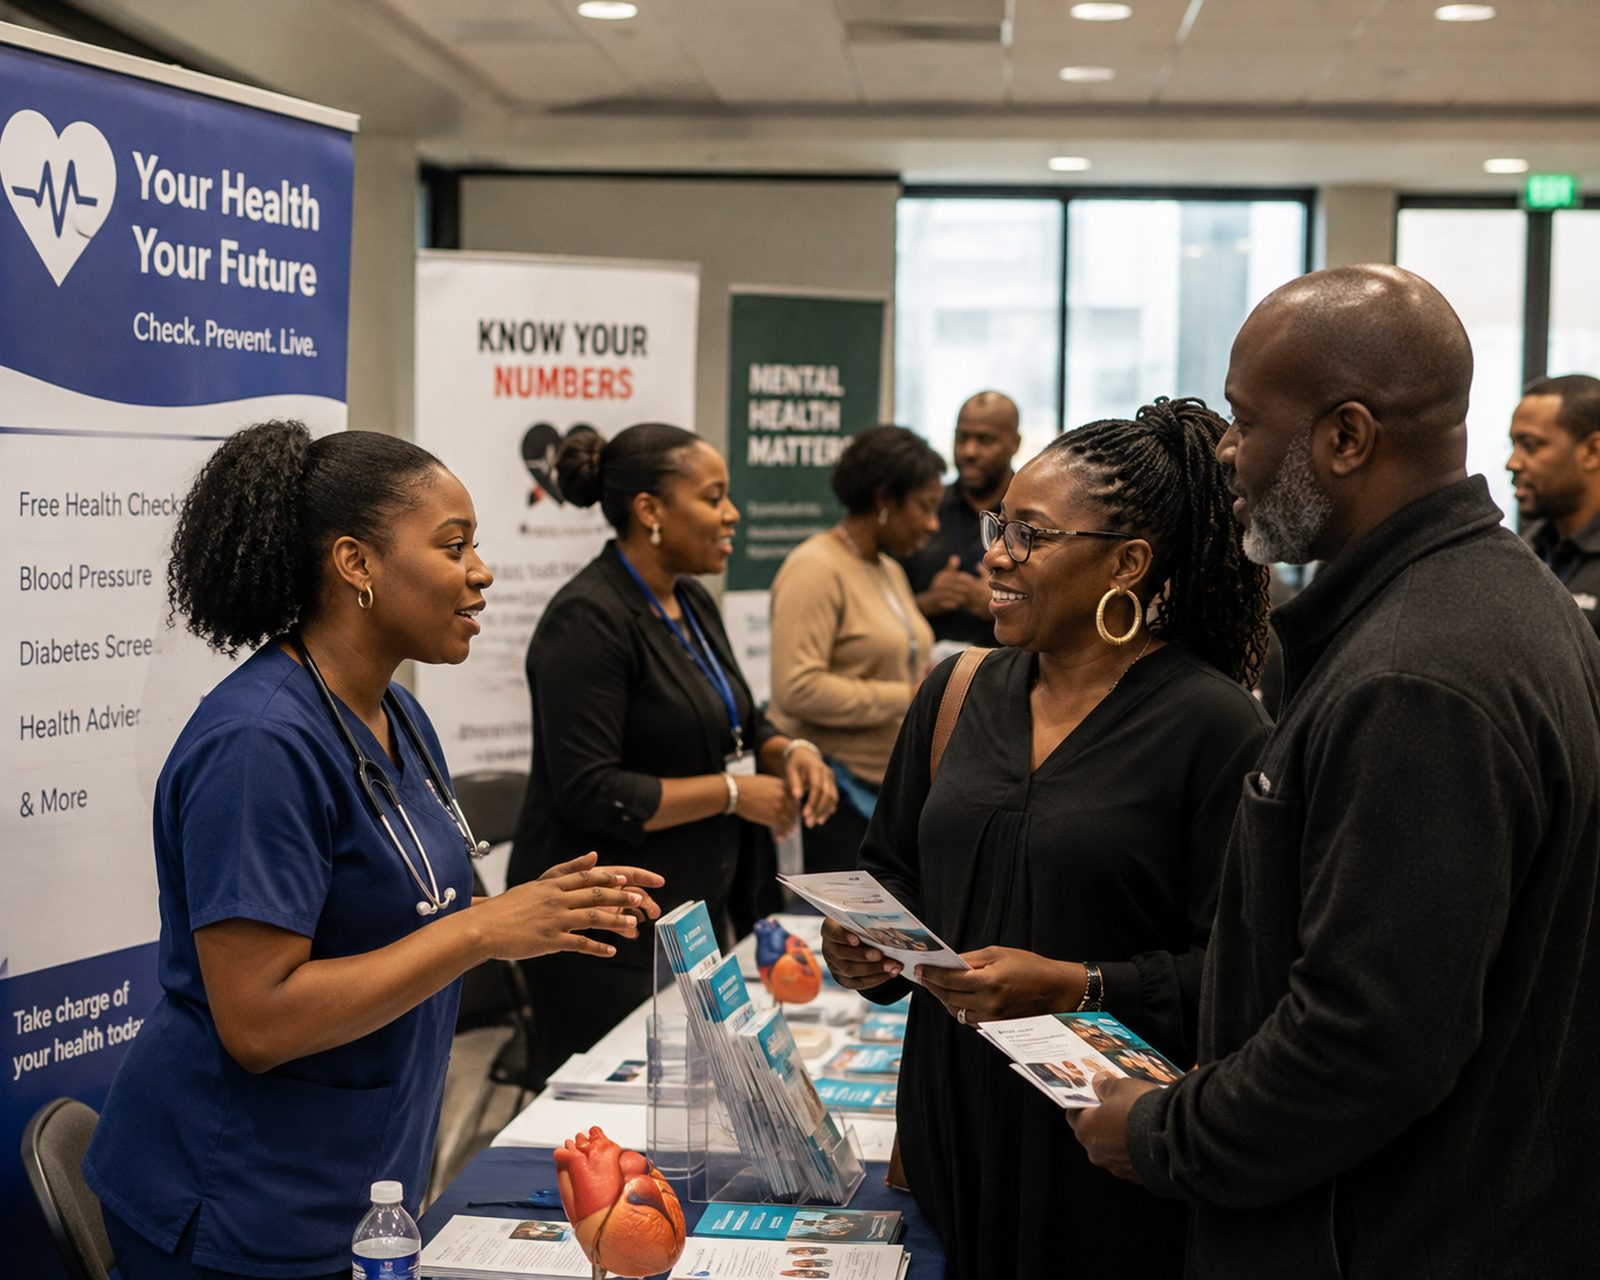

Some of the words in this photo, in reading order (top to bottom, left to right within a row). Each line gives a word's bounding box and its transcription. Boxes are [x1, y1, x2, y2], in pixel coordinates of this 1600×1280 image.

[132, 151, 212, 210] Your
[222, 169, 319, 231] Health
[132, 225, 211, 281] Your
[220, 238, 317, 296] Future
[133, 312, 200, 346] Check.
[205, 320, 276, 353] Prevent.
[280, 328, 318, 357] Live.
[479, 320, 564, 354] KNOW
[574, 324, 648, 357] YOUR
[494, 365, 633, 400] NUMBERS
[748, 399, 841, 431] HEALTH
[19, 491, 60, 517] Free
[65, 492, 122, 516] Health
[20, 564, 73, 591] Blood
[79, 564, 152, 589] Pressure
[20, 638, 99, 666] Diabetes
[105, 634, 152, 658] Scree
[20, 709, 80, 740] Health
[20, 791, 34, 818] &
[41, 788, 88, 814] More
[13, 1006, 52, 1035] Take
[55, 992, 109, 1024] charge
[113, 980, 130, 1007] of
[13, 1048, 51, 1081] your
[54, 1026, 104, 1062] health
[107, 1016, 144, 1046] toda
